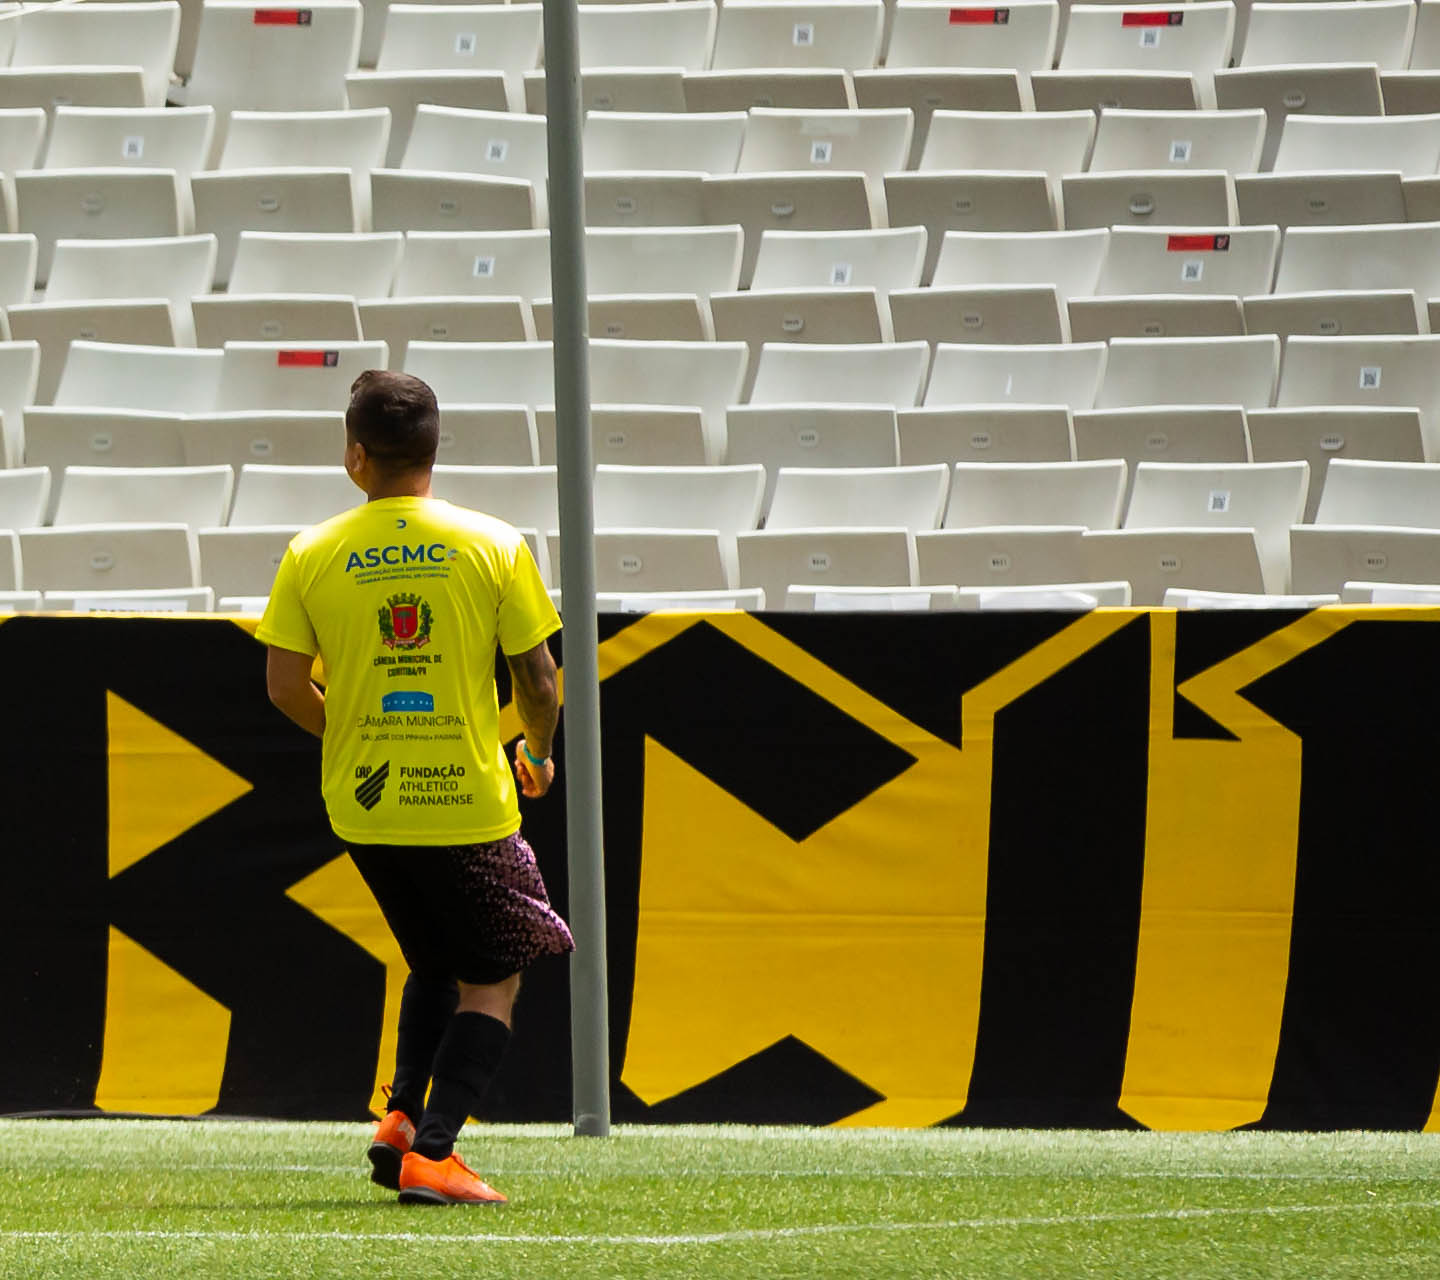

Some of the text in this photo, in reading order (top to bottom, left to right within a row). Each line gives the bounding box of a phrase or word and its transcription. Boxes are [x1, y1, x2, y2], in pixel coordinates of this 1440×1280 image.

[345, 543, 446, 573] ASCMC
[357, 714, 468, 727] CÂMARA MUNICIPAL
[355, 765, 373, 779] CAP
[399, 763, 466, 780] FUNDAÇÃO
[399, 780, 459, 793] ATHLETICO
[398, 793, 474, 806] PARANAENSE
